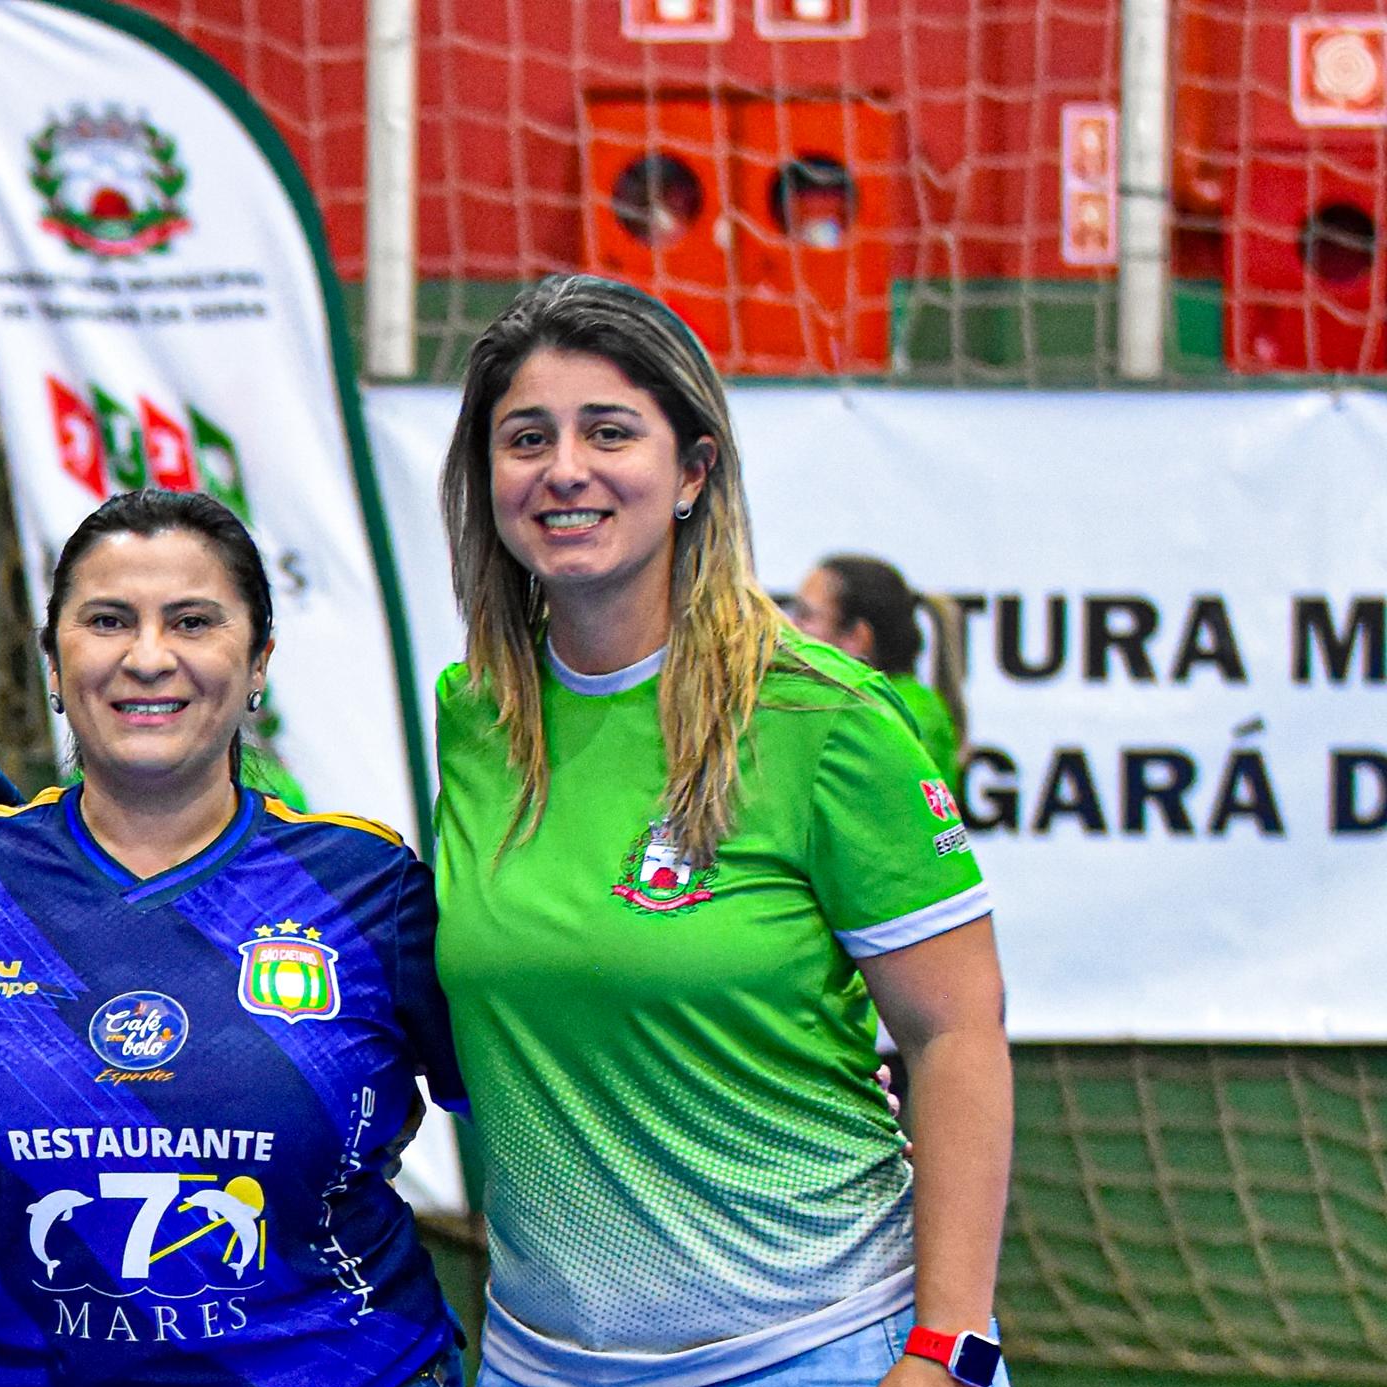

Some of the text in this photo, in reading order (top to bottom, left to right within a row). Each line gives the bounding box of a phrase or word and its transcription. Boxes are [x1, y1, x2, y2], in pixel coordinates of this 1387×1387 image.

[105, 1009, 162, 1038] Café
[122, 1031, 167, 1056] bolo
[7, 1127, 275, 1161] RESTAURANTE
[98, 1173, 180, 1279] 7
[54, 1296, 247, 1342] MARES
